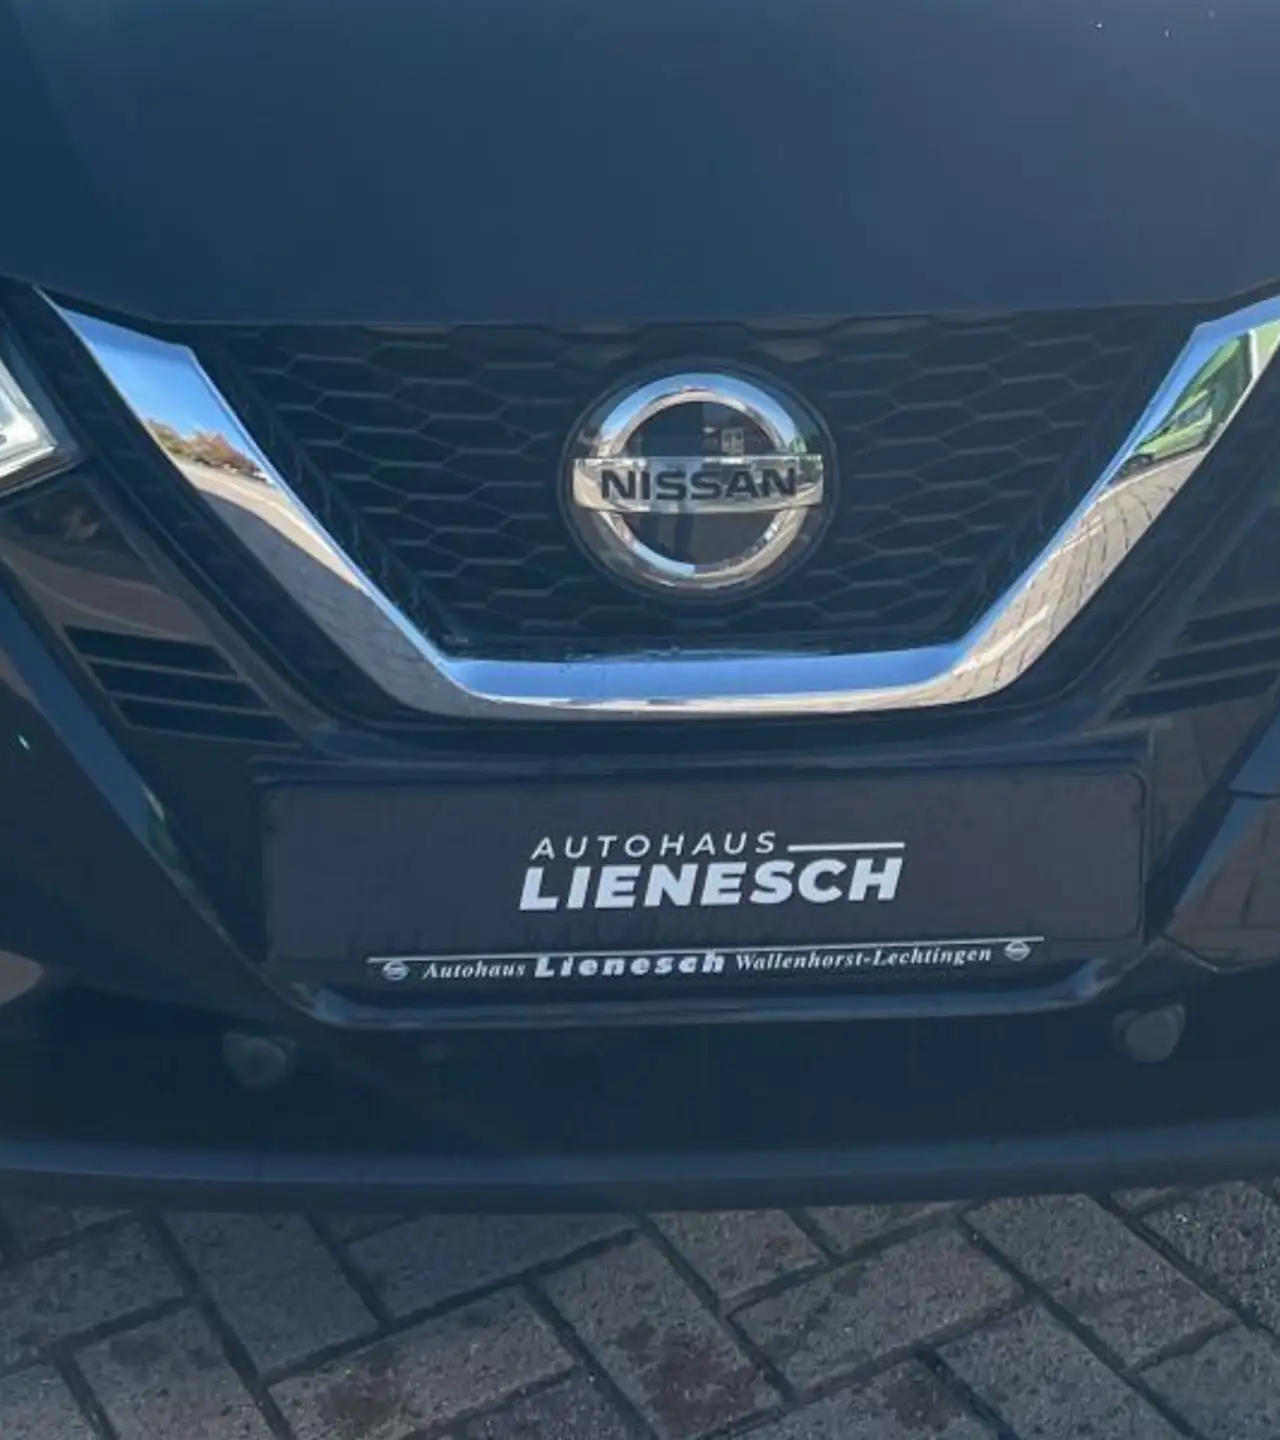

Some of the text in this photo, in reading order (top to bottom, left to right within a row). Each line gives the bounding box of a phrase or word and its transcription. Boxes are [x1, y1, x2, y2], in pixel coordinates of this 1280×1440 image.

[600, 467, 797, 501] NISSAN
[531, 831, 776, 860] AUTOHAUS
[519, 857, 904, 911] LIENESCH
[421, 946, 992, 980] Autohaus Lienesch Wallenhorst-Lechtingen
